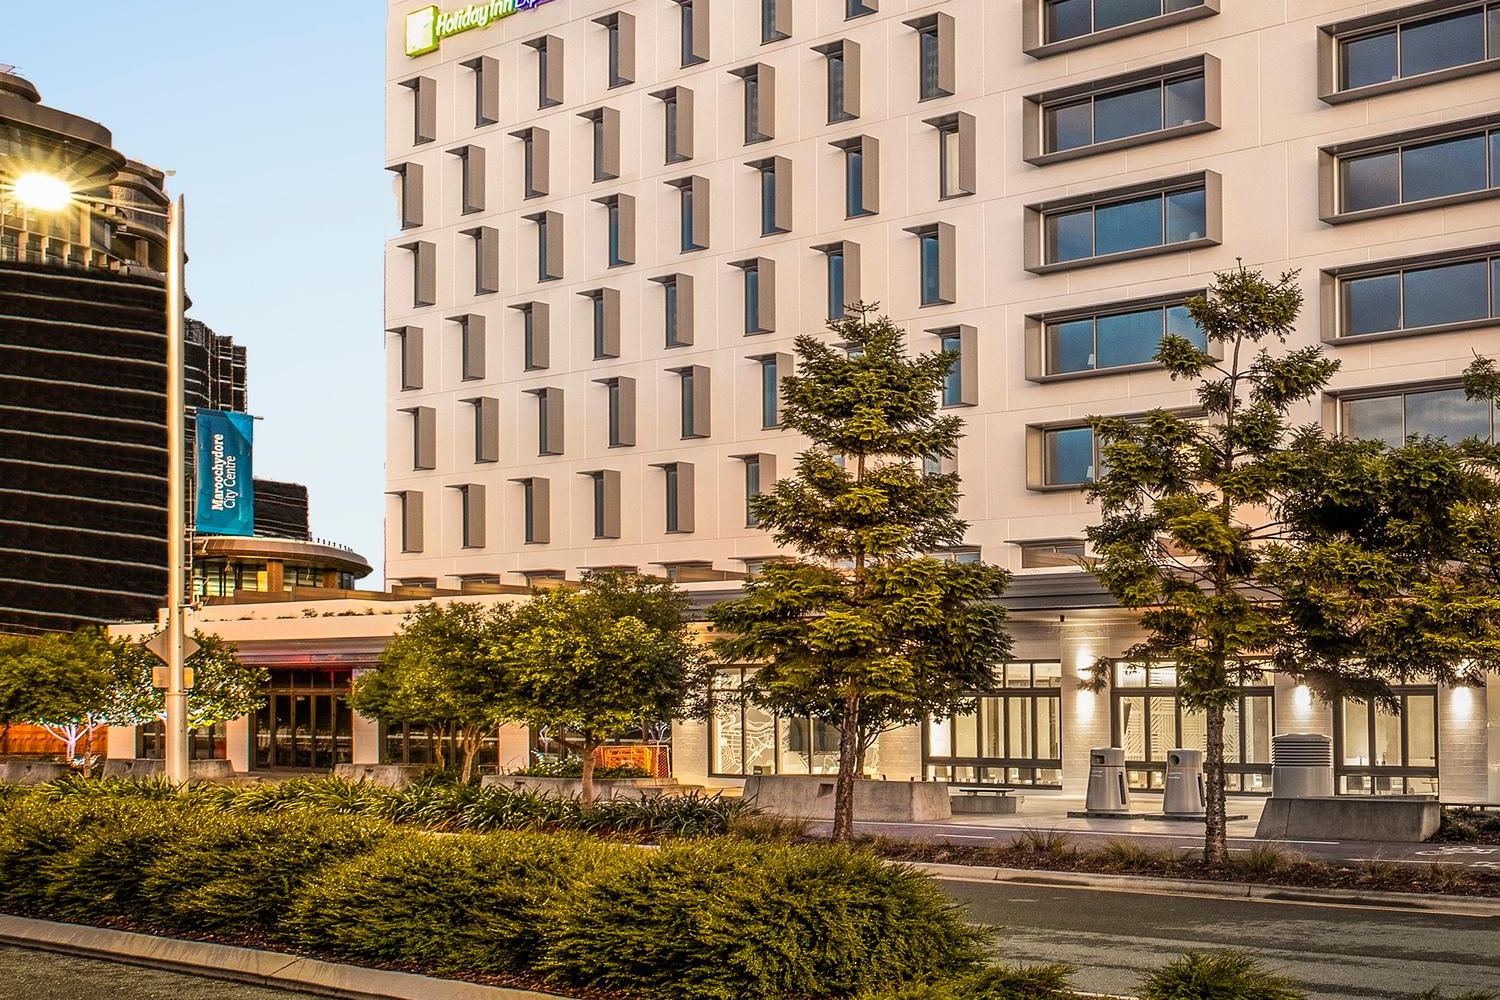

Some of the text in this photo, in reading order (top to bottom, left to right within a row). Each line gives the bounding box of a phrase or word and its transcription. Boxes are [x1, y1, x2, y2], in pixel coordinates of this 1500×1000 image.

[436, 4, 490, 36] Holiday
[211, 433, 226, 512] Maroochydore
[223, 455, 239, 509] City Centre
